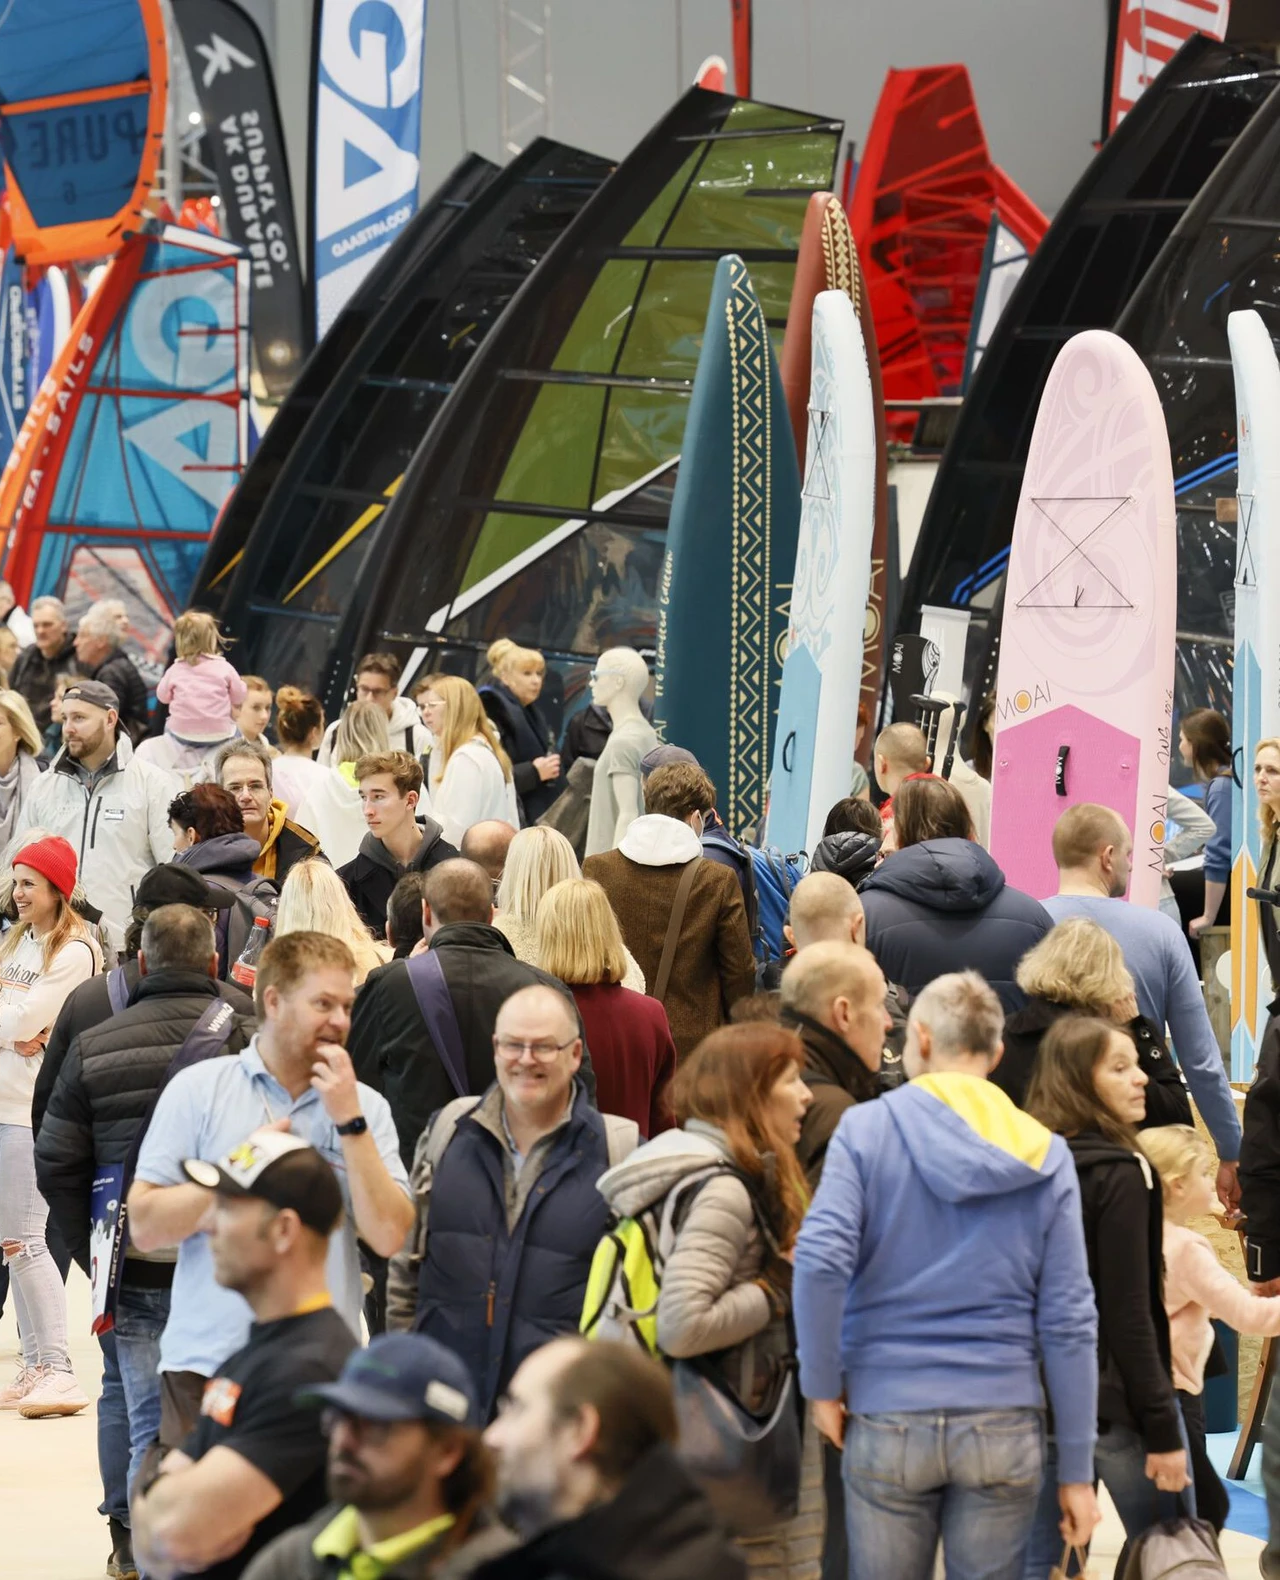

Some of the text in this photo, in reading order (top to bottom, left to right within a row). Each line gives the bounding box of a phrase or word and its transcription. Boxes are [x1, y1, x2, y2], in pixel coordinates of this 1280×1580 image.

[46, 332, 94, 435] SAILS
[891, 642, 904, 674] MOAI
[996, 679, 1052, 724] MOAI
[1055, 756, 1064, 785] MOAI
[1147, 794, 1168, 874] MOAI
[110, 1202, 128, 1288] OSCULATI
